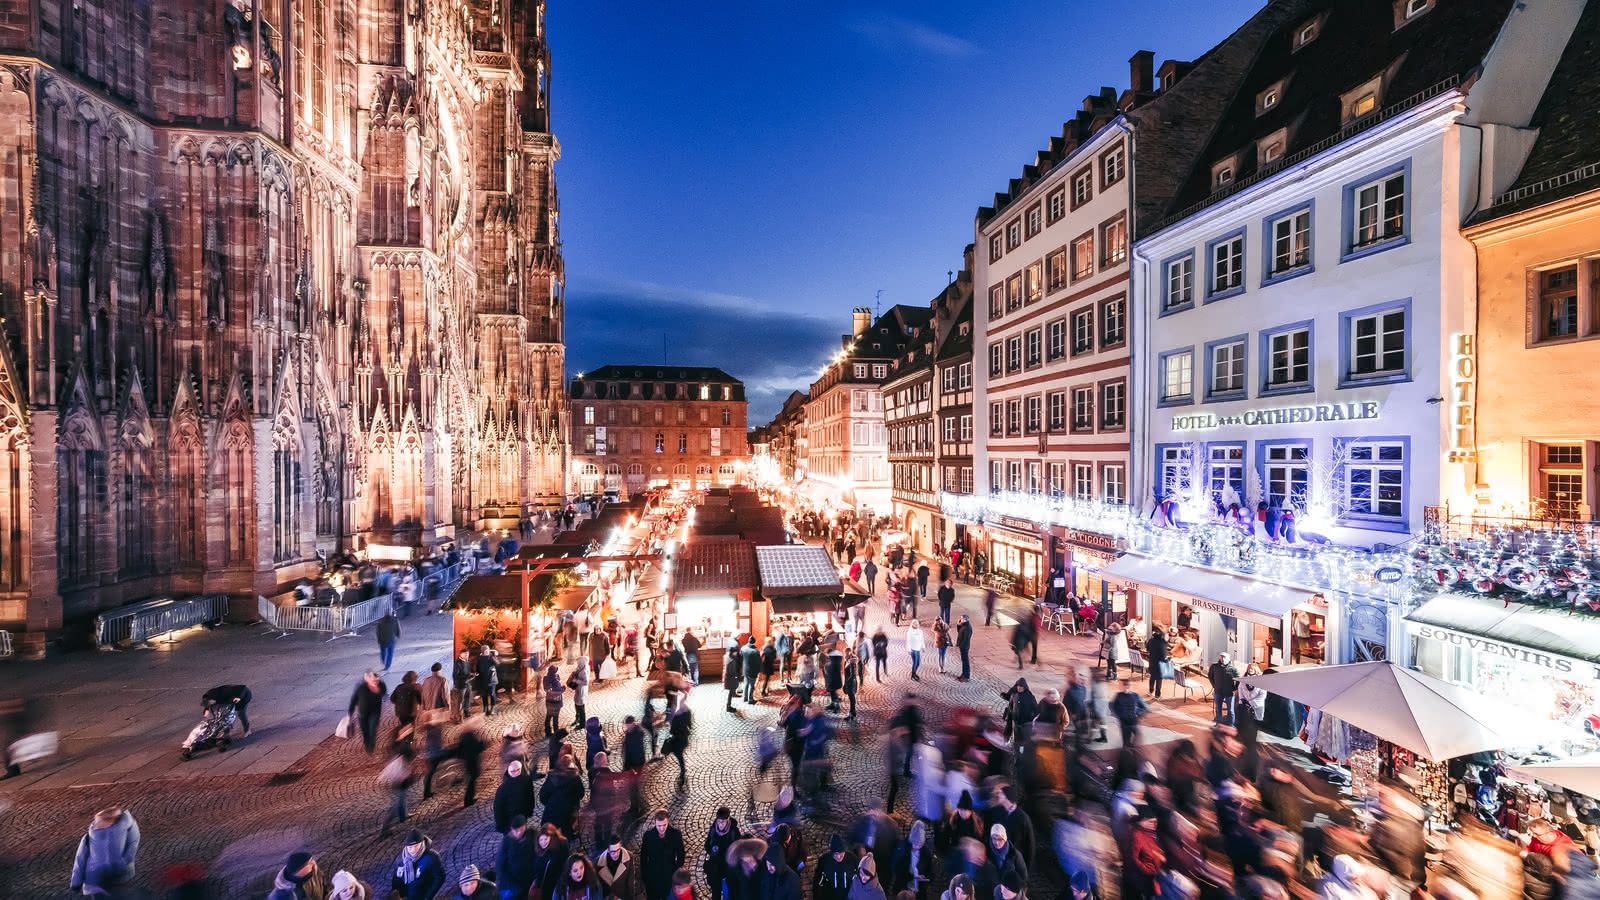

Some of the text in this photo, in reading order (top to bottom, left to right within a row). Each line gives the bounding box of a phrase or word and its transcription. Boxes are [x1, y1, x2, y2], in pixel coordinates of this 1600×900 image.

[1456, 334, 1474, 449] HOTEL
[1171, 402, 1378, 430] HOTEL CATHEDRALE
[1079, 533, 1117, 549] CIGOGNE
[1124, 580, 1236, 616] CAFE BRASSERIE
[1419, 626, 1572, 673] SOUVENIRS
